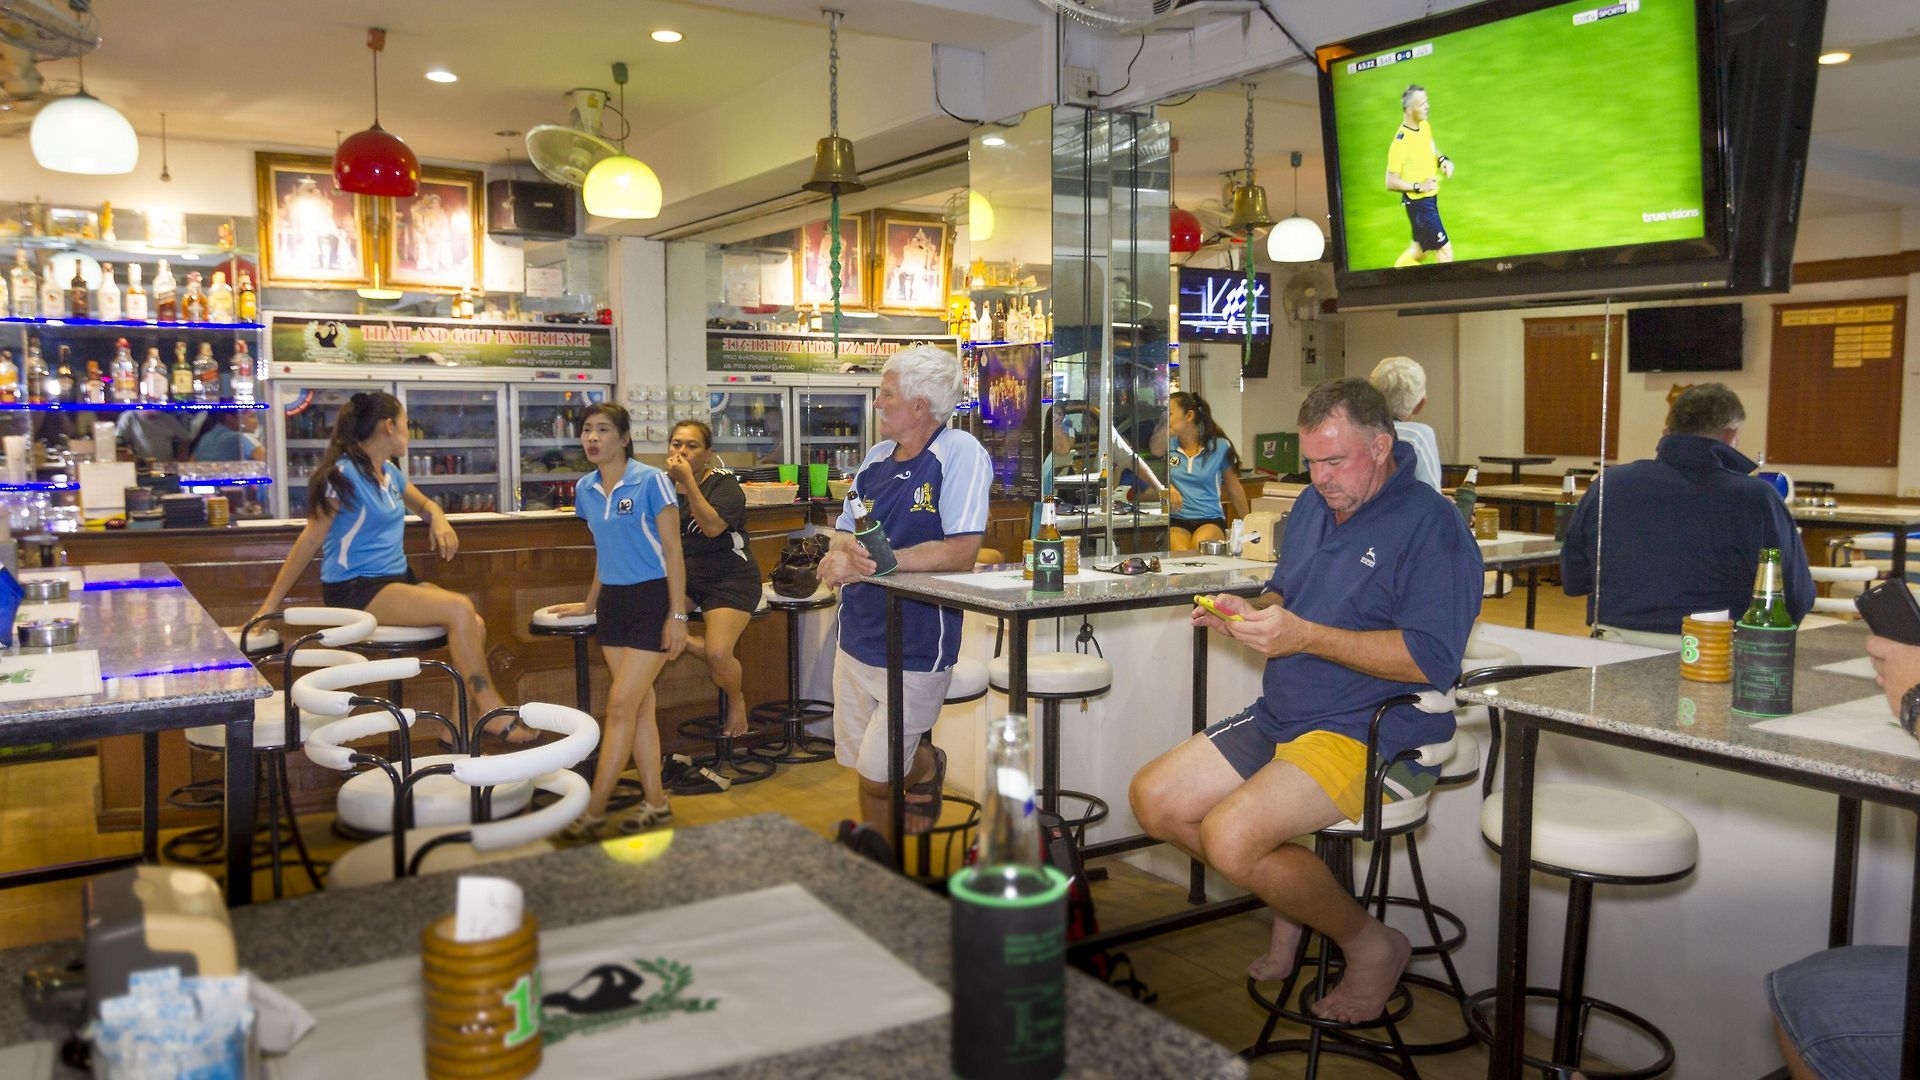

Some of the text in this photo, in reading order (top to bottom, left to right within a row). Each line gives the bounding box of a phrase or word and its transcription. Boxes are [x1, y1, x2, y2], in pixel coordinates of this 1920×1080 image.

[360, 325, 591, 347] THAILAND GOLF EXPERIENCE
